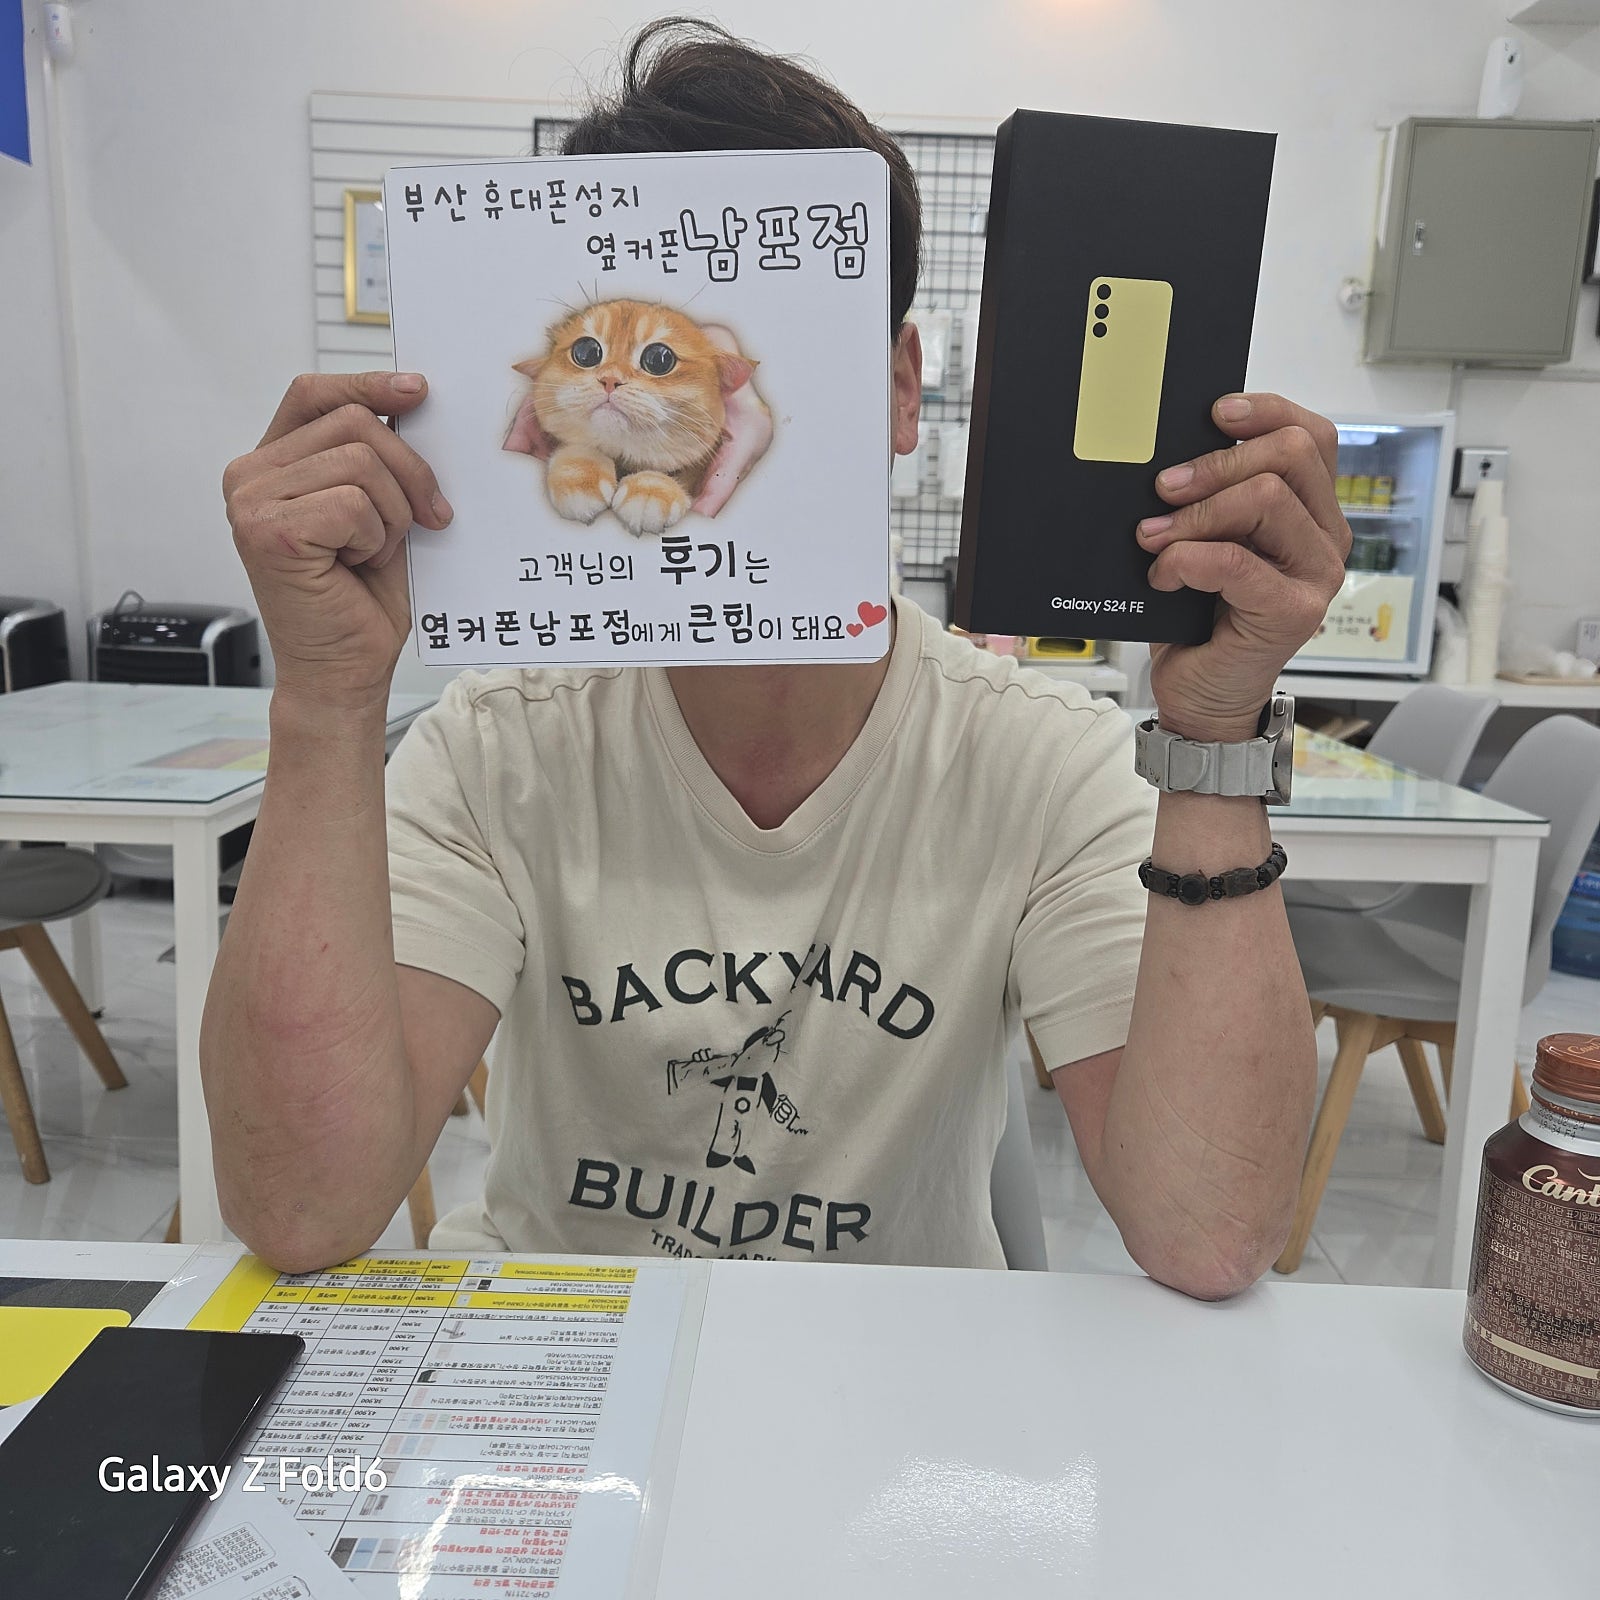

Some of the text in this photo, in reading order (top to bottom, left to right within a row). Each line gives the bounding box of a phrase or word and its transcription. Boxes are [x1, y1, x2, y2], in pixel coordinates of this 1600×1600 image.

[405, 179, 640, 225] 부산 휴대폰성지
[586, 202, 869, 282] 옆커폰 남포점
[518, 535, 770, 586] 고객님의 후기는
[791, 615, 846, 642] 돼요
[1051, 596, 1145, 614] Galaxy S24 FE
[561, 943, 935, 1040] BACKYARD
[568, 1158, 872, 1253] BUILDER
[651, 1229, 703, 1260] TRAD
